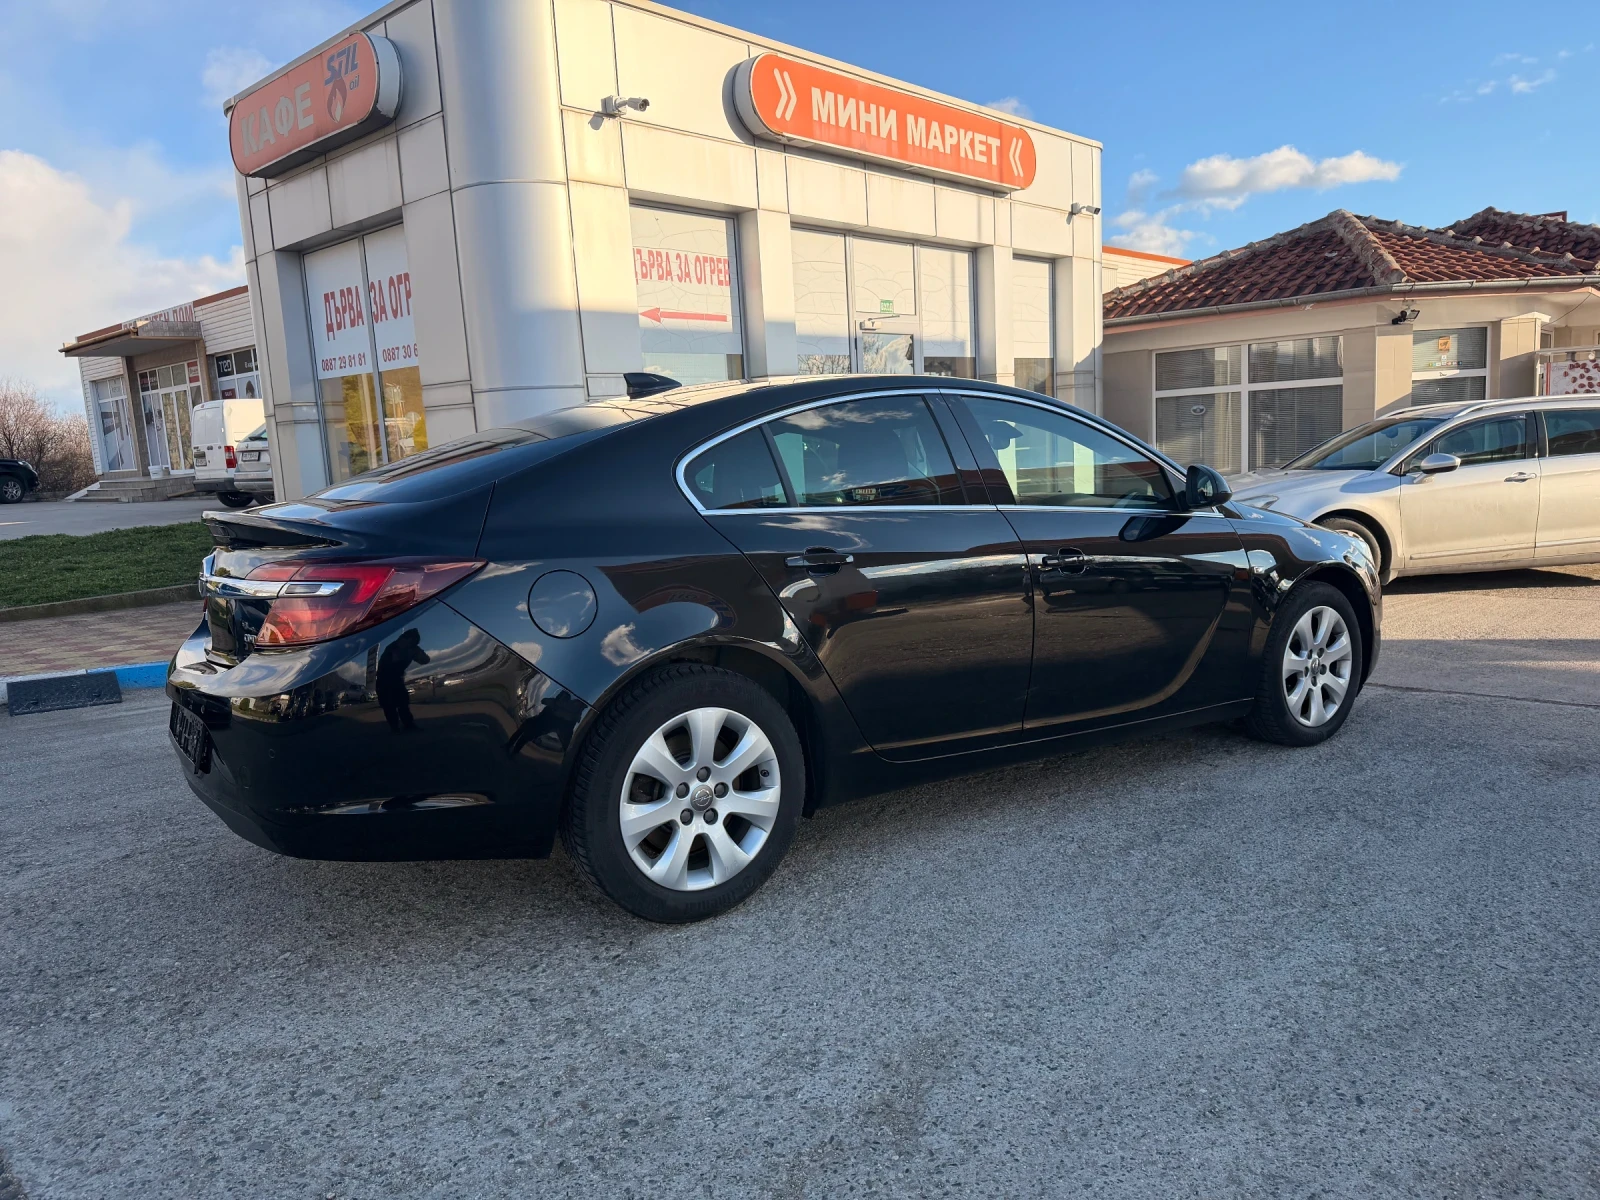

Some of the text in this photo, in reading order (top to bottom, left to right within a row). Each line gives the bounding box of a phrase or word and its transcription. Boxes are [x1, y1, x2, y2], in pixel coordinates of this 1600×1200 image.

[324, 41, 359, 86] STIL
[349, 75, 360, 90] oil
[241, 81, 314, 158] КАФЕ
[810, 87, 1001, 165] МИНИ МАРКЕТ
[632, 248, 731, 286] ЪРВА ЗА ОГРЕВ
[324, 286, 364, 341] ДЪРВА
[369, 280, 388, 324] ЗА
[322, 352, 366, 372] 0887 29 81 81
[382, 346, 400, 362] 0887
[402, 344, 412, 359] 30
